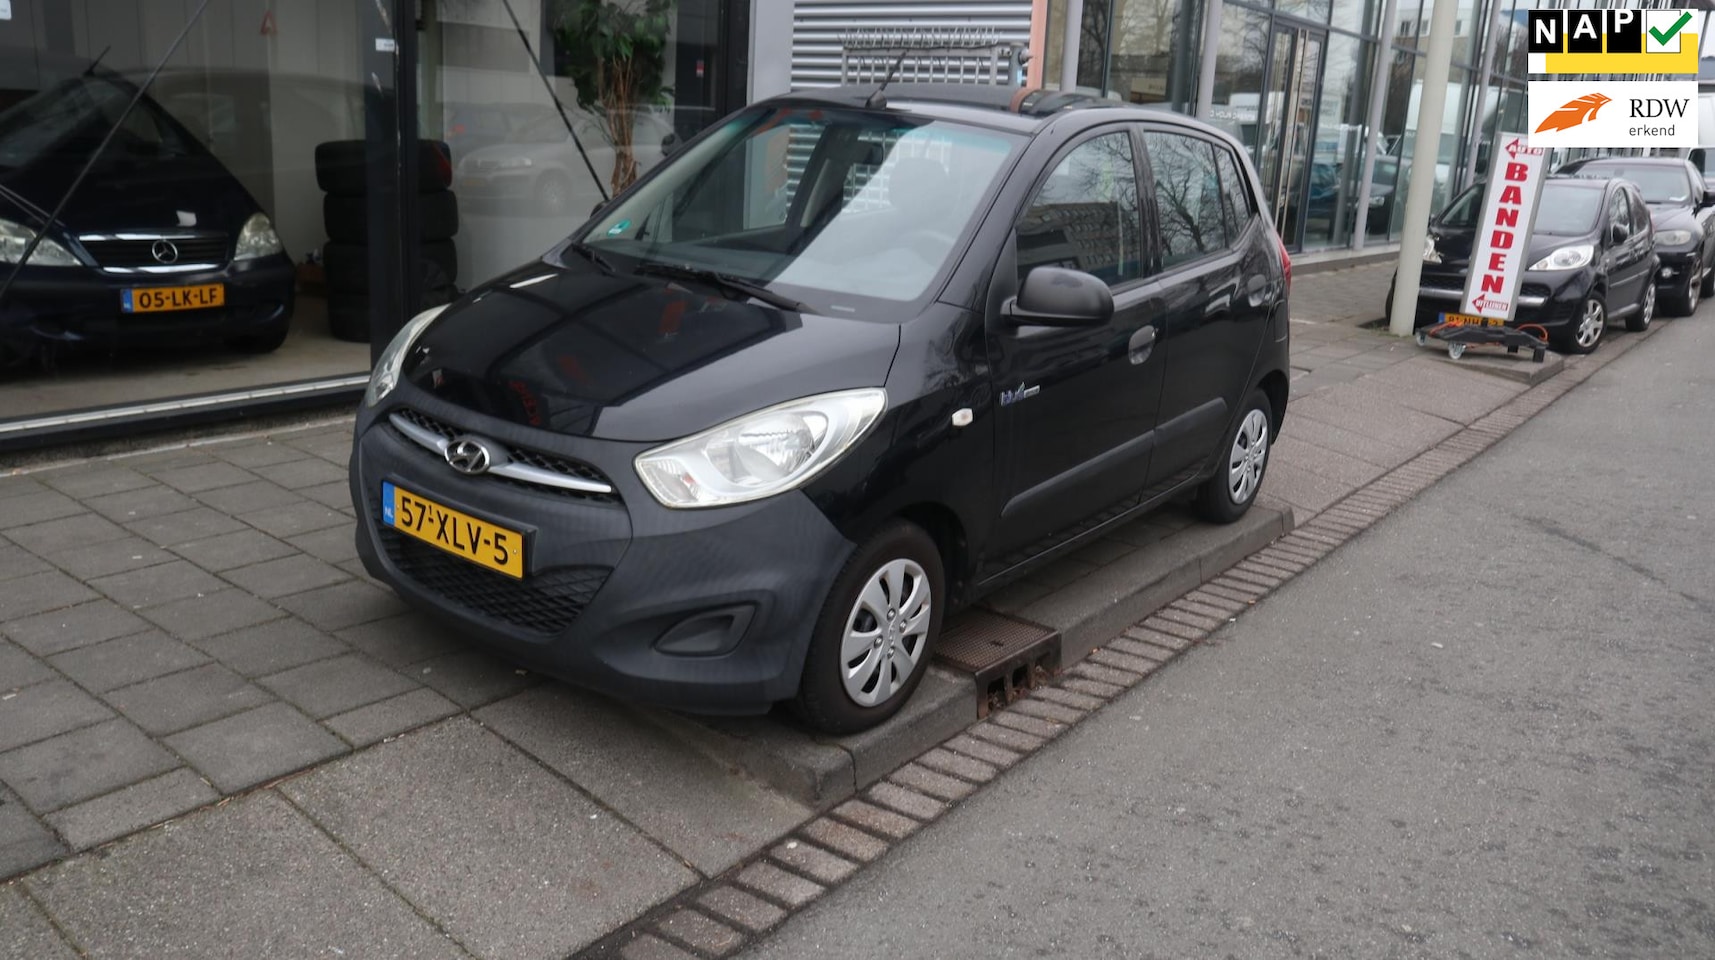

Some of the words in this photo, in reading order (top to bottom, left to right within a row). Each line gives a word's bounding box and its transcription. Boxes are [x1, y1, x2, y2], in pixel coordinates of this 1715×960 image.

[1507, 144, 1543, 156] AUTO
[1481, 162, 1529, 294] BANDEN
[139, 287, 217, 309] 05-LK-LF
